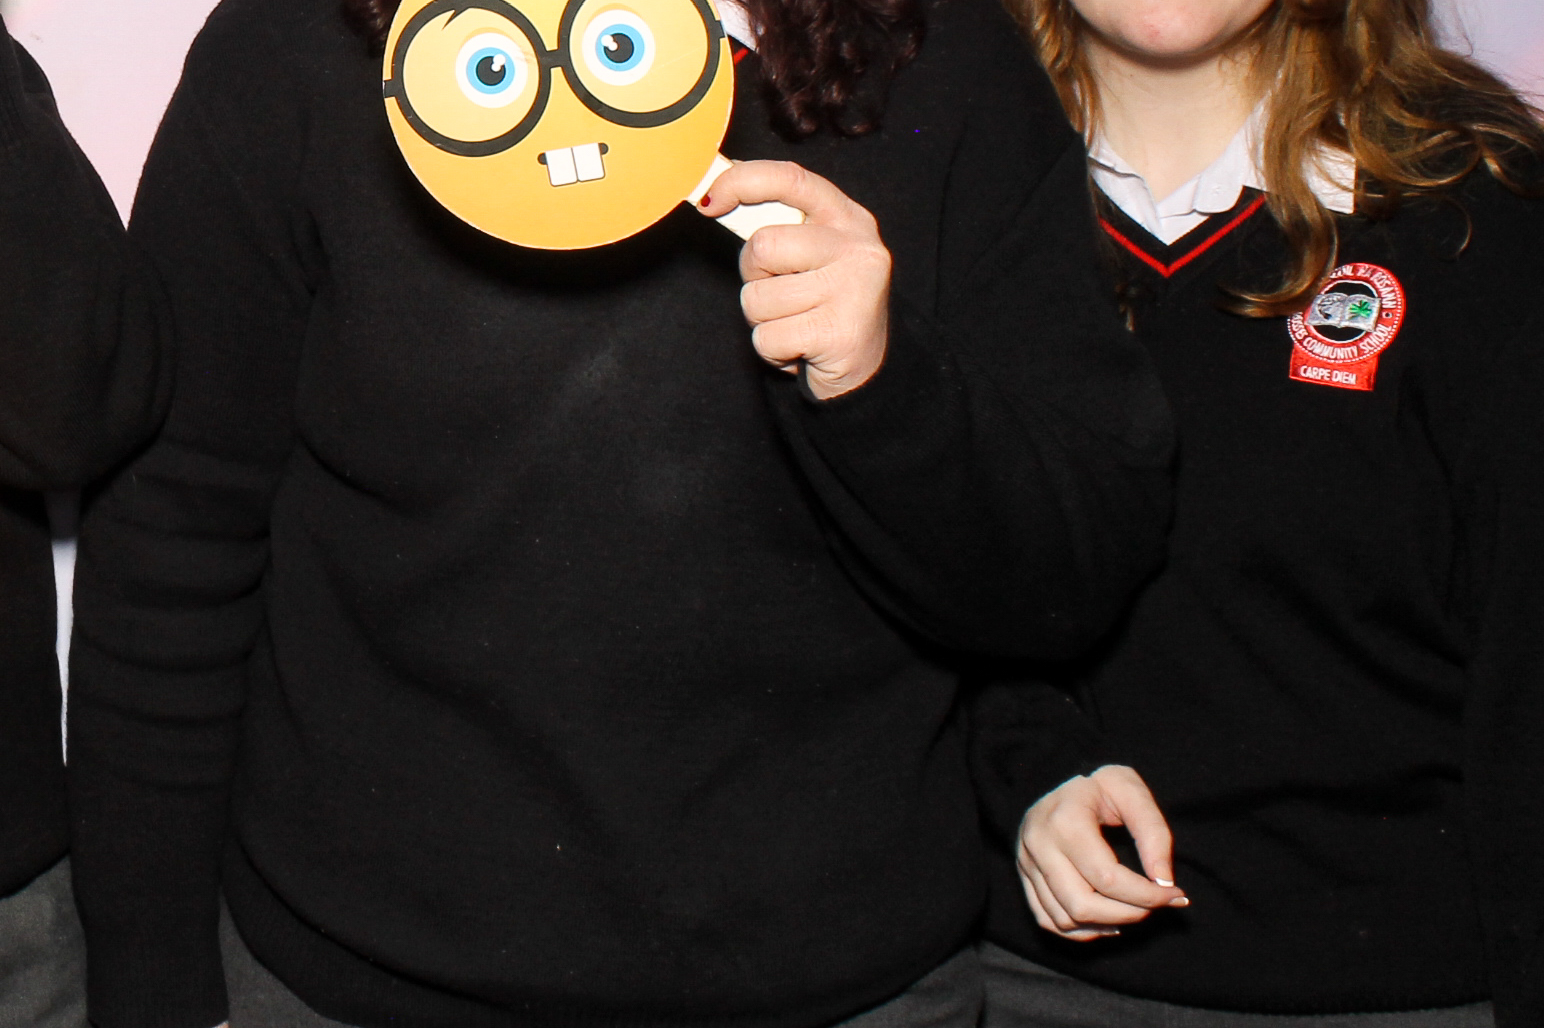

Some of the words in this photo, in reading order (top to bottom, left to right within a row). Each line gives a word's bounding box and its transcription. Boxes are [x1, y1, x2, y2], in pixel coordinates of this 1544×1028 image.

[1303, 337, 1358, 359] COMMUNITY
[1359, 324, 1392, 354] SCHOOL
[1300, 365, 1331, 381] CARPE
[1331, 370, 1357, 385] DIEM
